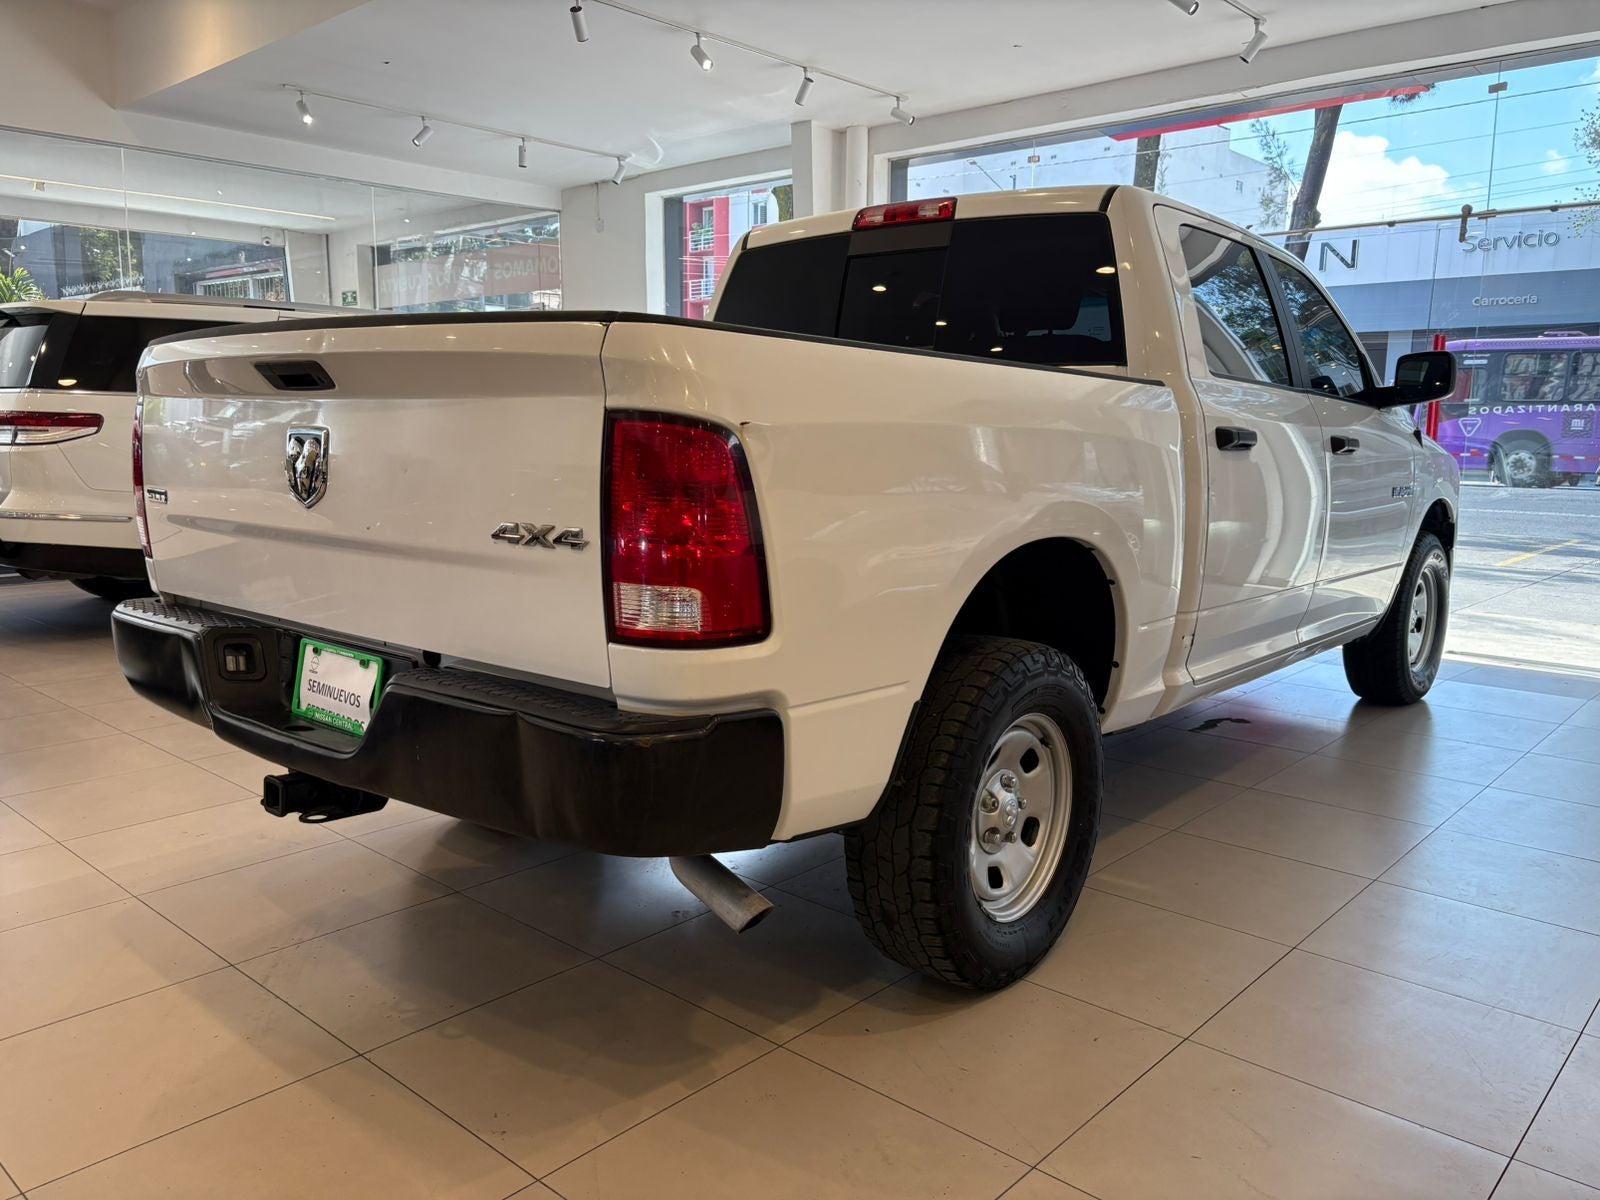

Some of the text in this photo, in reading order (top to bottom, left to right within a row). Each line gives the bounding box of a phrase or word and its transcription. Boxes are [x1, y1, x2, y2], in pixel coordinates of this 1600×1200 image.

[1462, 229, 1561, 253] Servicio
[1319, 238, 1360, 272] N
[1472, 293, 1539, 307] Carrocería
[307, 678, 361, 708] SEMINUEVOS
[314, 712, 333, 723] NISSAN
